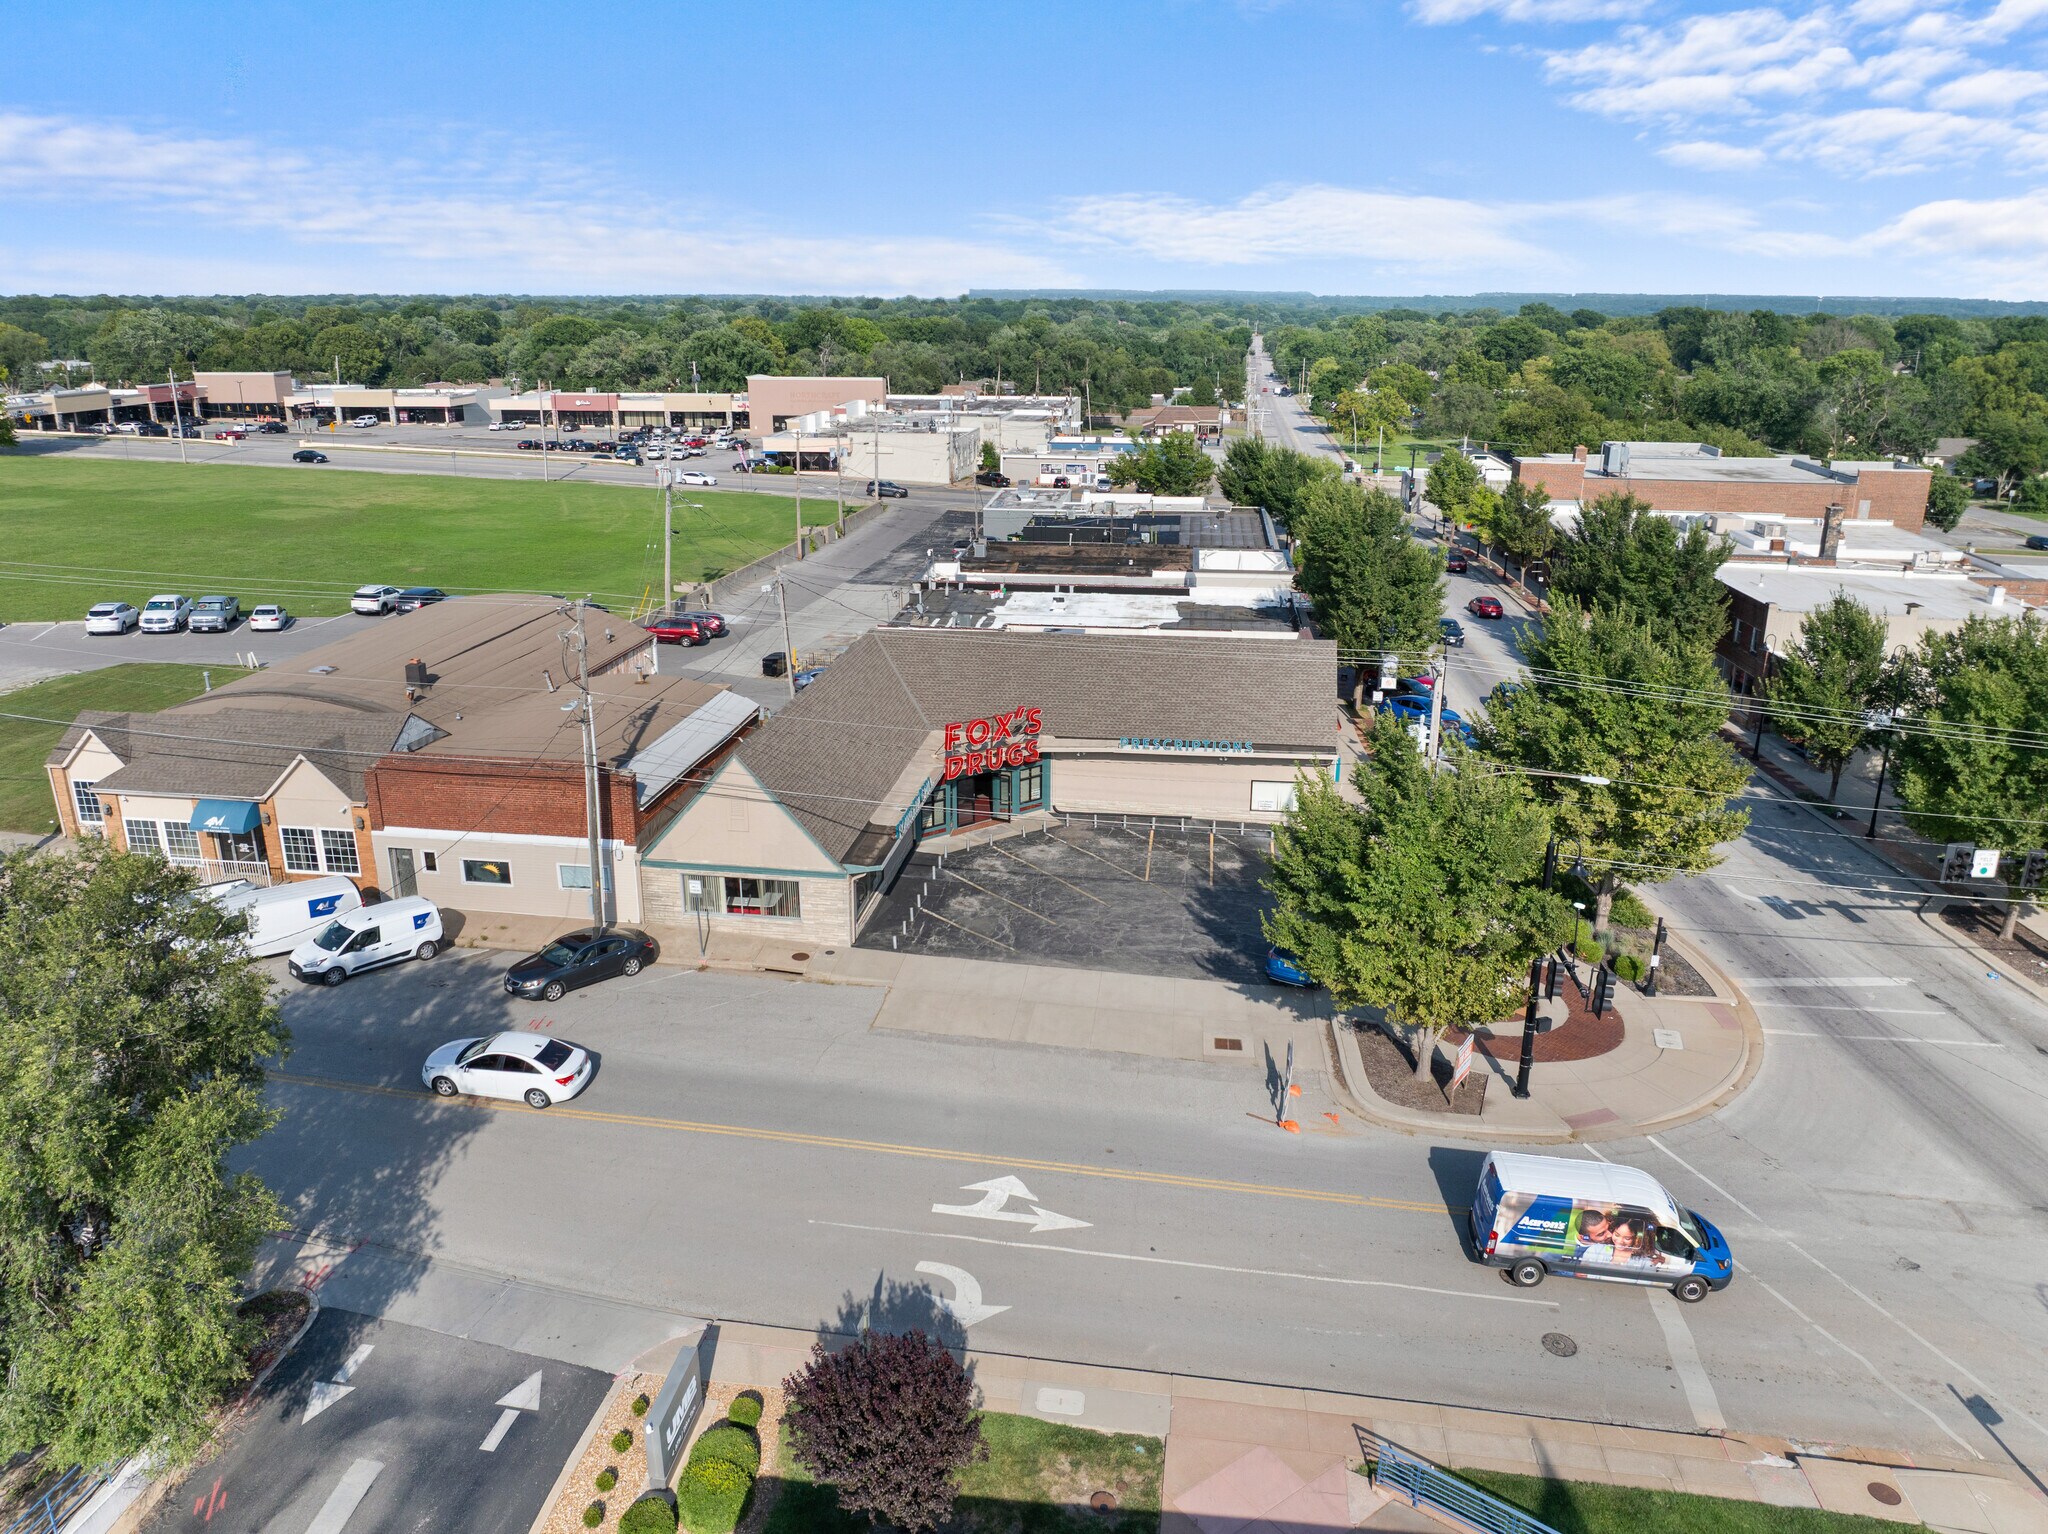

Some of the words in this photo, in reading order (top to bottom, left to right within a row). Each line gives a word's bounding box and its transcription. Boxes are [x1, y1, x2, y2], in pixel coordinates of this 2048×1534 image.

[945, 706, 1042, 751] FOX'S
[1120, 737, 1253, 753] PRESCRIPTIONS
[945, 739, 1040, 780] DRUGS
[1518, 1215, 1567, 1230] Aaron's
[666, 1375, 698, 1445] UMB
